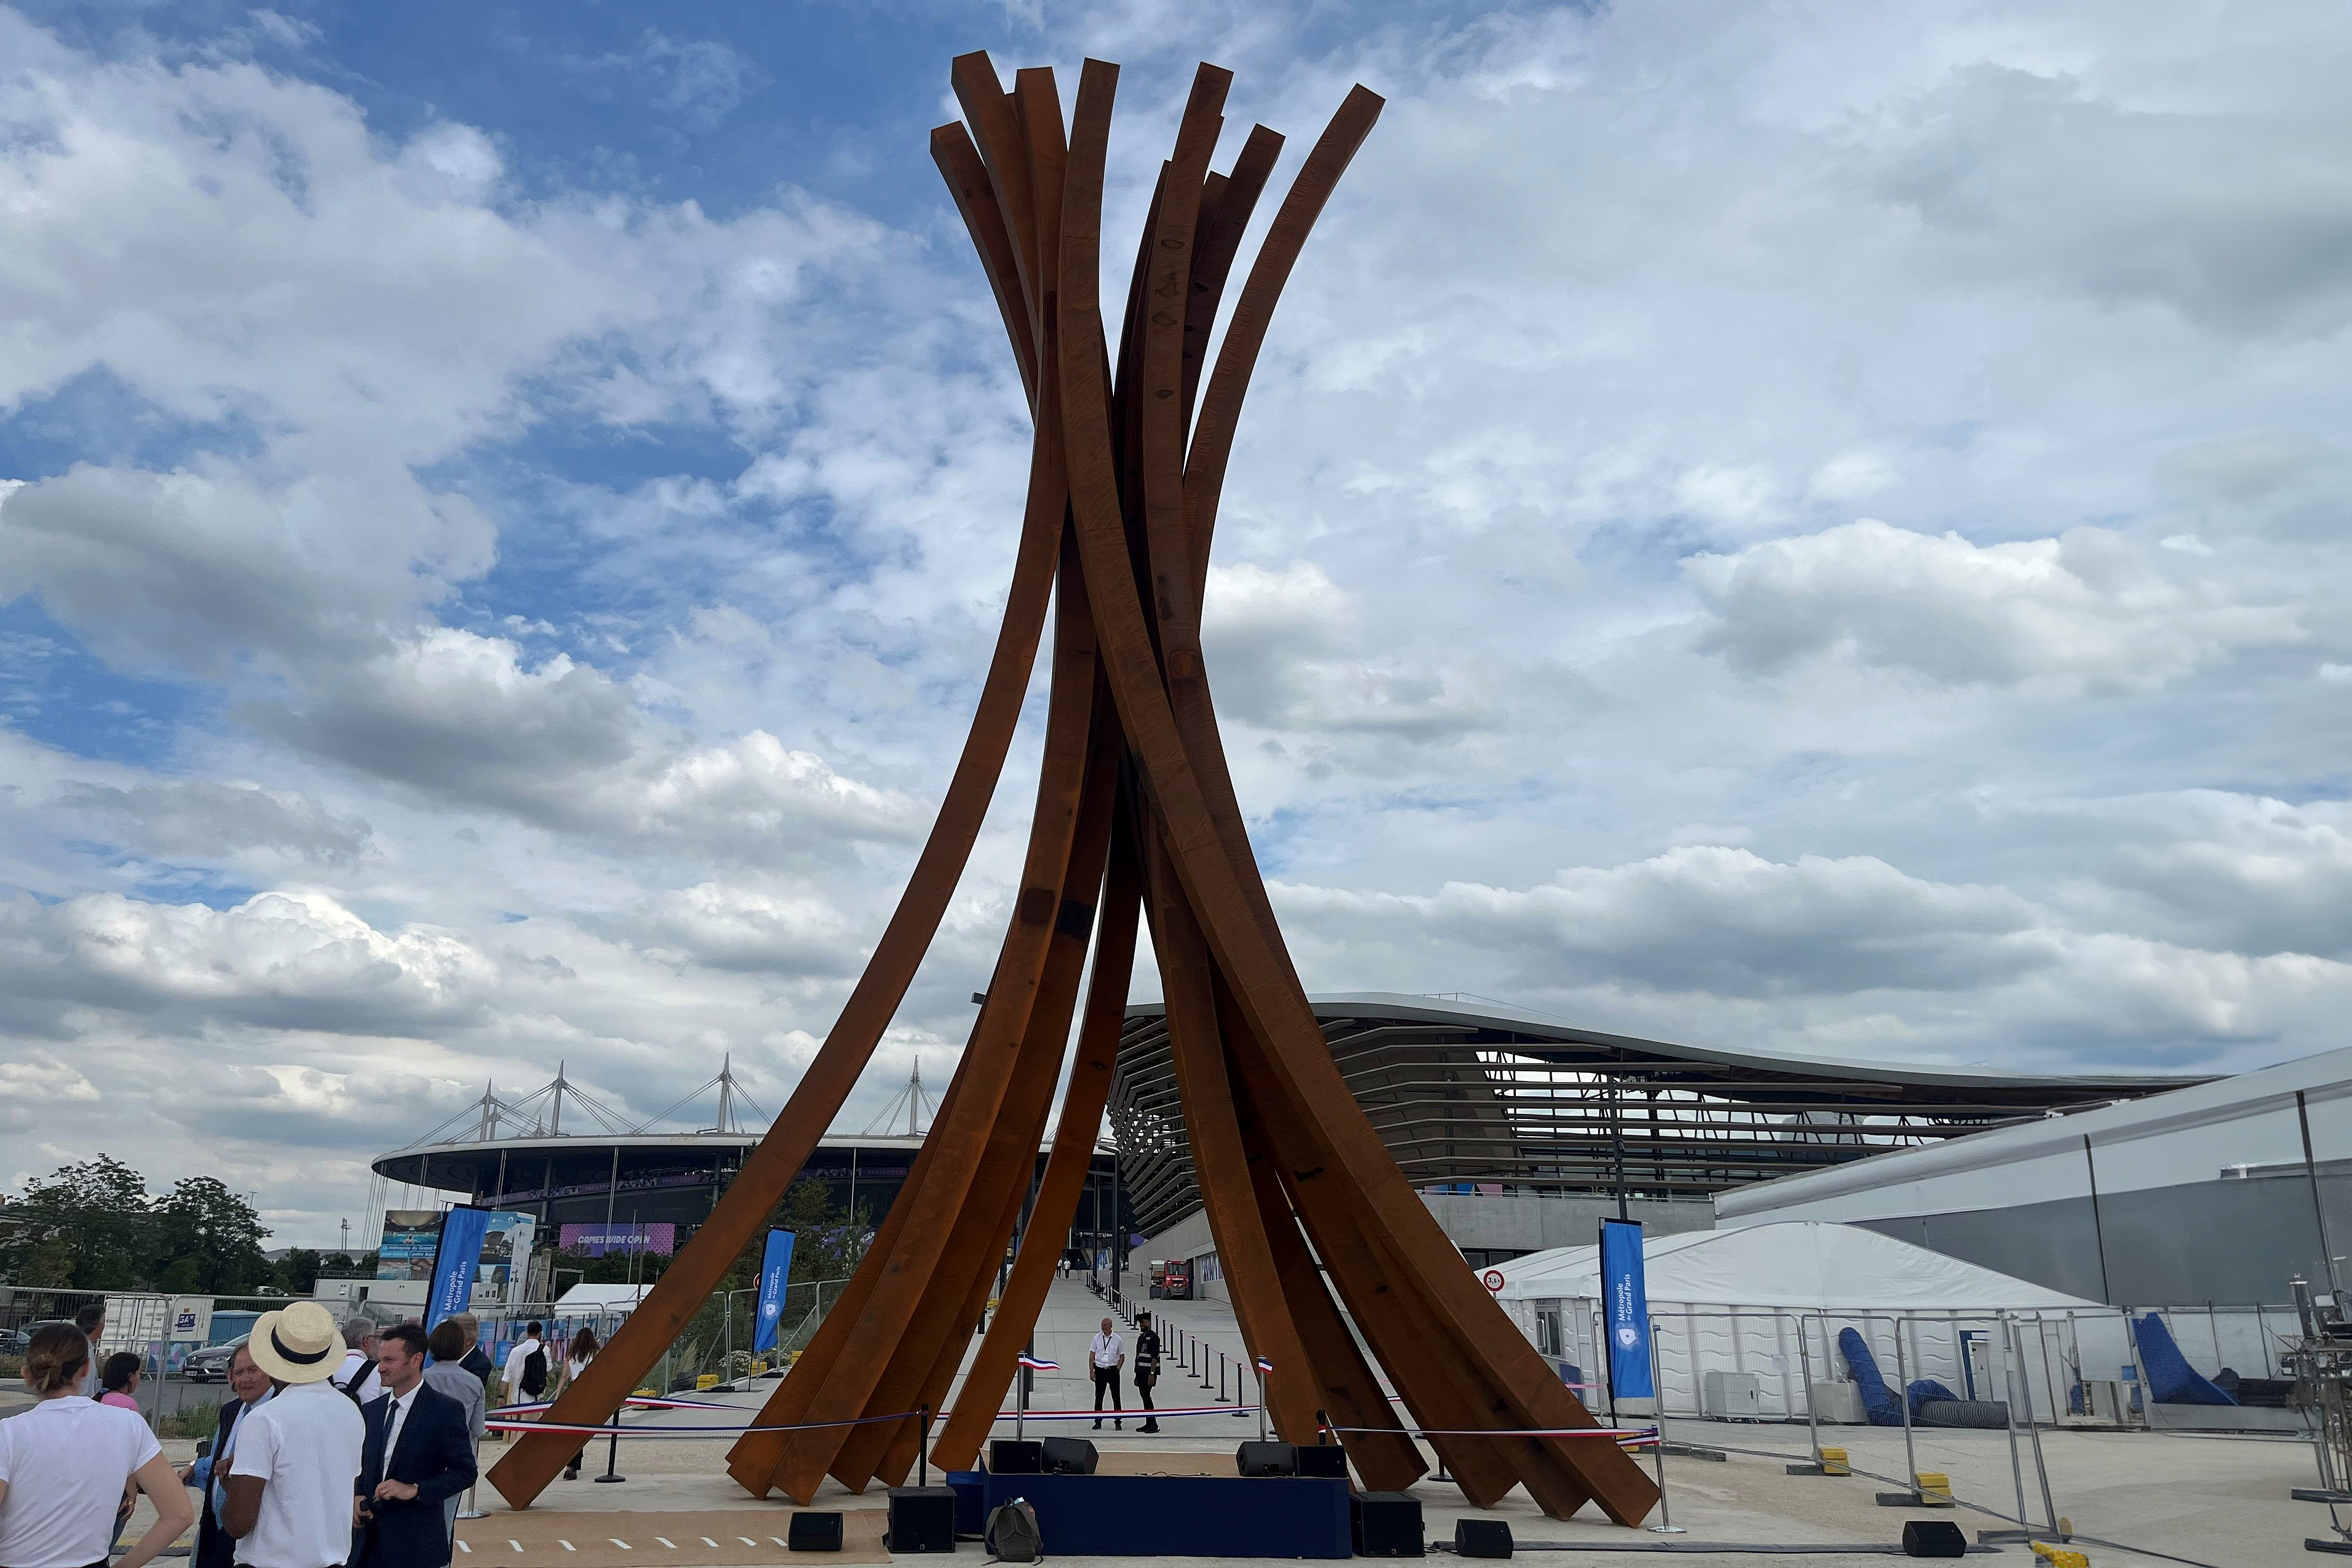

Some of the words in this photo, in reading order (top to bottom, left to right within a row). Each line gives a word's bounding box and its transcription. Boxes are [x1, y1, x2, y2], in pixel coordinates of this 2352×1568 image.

[578, 1236, 605, 1244] GAMES
[606, 1235, 627, 1243] WIDE
[458, 1261, 467, 1279] Paris
[444, 1270, 457, 1311] Métropole
[454, 1281, 463, 1304] Grand
[1617, 1283, 1625, 1321] Métropole
